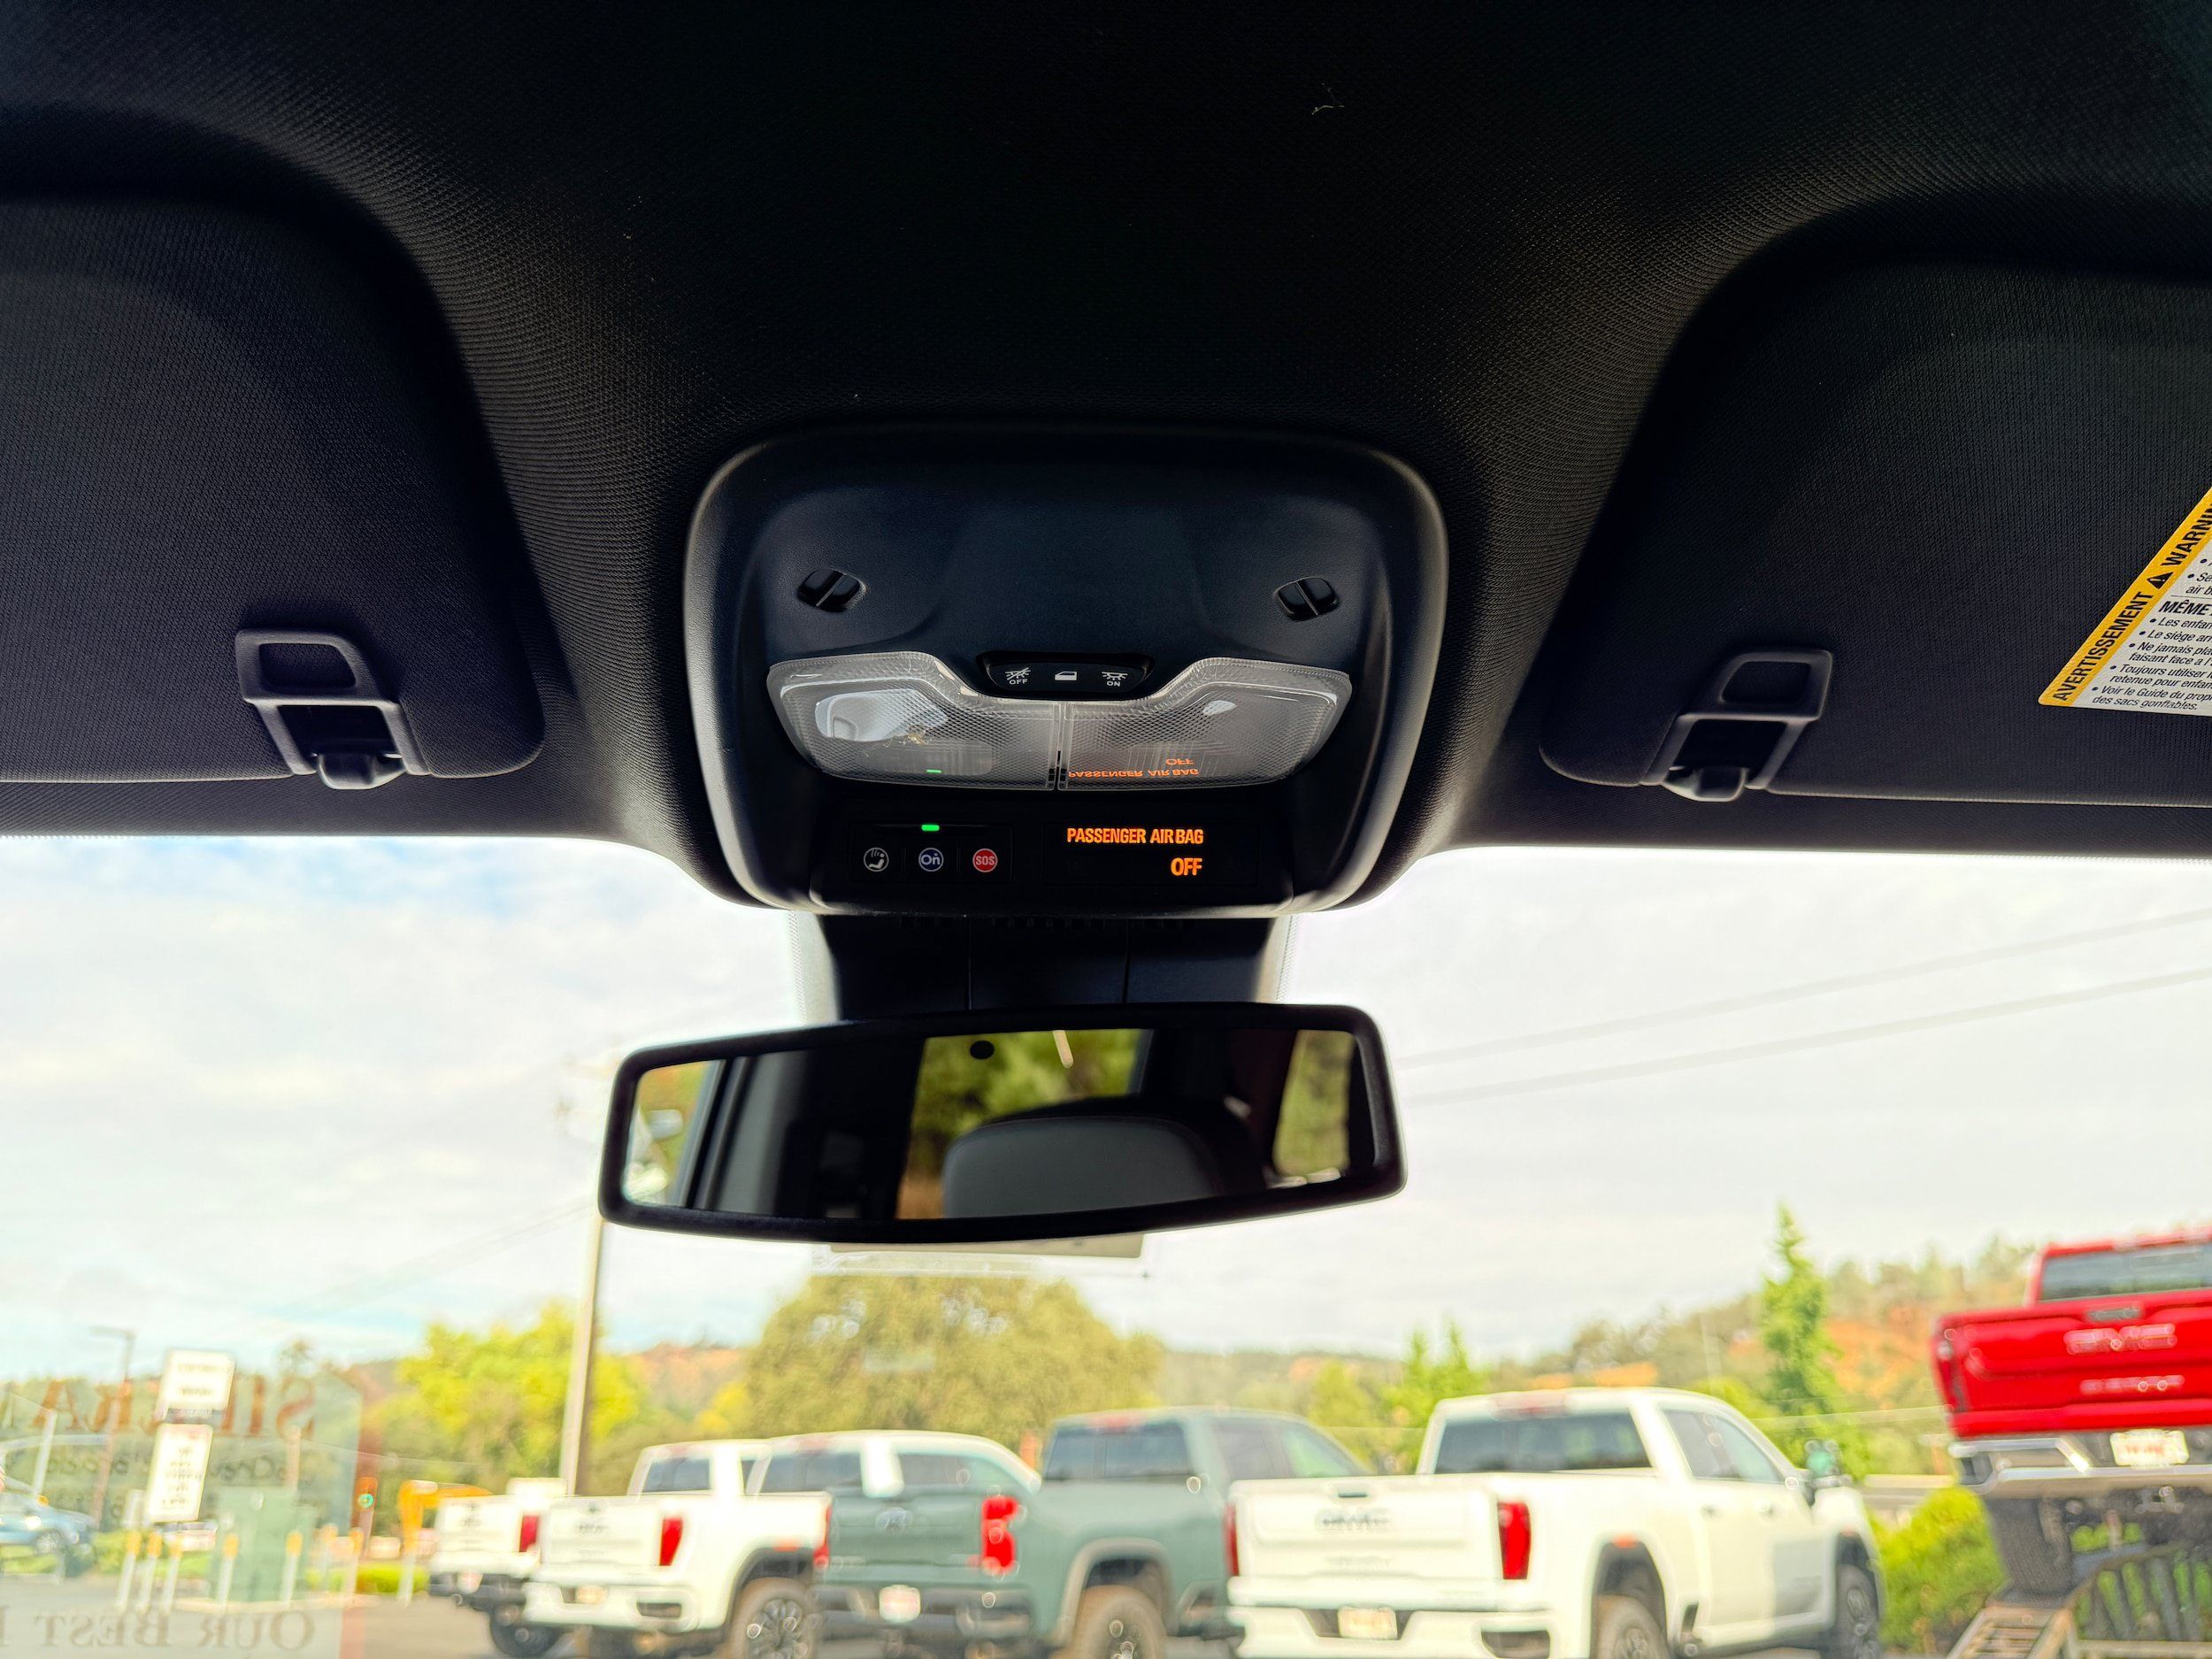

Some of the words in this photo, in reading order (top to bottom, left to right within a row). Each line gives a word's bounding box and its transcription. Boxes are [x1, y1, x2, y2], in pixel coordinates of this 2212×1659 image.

[2196, 572, 2212, 582] Se
[2185, 584, 2205, 594] air
[2158, 599, 2212, 616] MÊME
[2158, 617, 2180, 627] Les
[2147, 629, 2163, 639] Le
[2164, 630, 2196, 642] siège
[2052, 592, 2154, 701] AVERTISSEMENT
[2137, 641, 2154, 651] Ne
[2154, 642, 2193, 654] jamais
[2192, 646, 2212, 656] pla
[2128, 652, 2169, 664] faisant
[2169, 655, 2194, 665] face
[2120, 664, 2167, 676] Toujours
[2168, 668, 2208, 679] utiliser
[2109, 674, 2153, 685] retenue
[2152, 678, 2182, 687] pour
[2181, 680, 2212, 689] enfan
[2101, 685, 2124, 695] Voir
[2124, 687, 2135, 696] le
[2136, 687, 2169, 698] Guide
[2169, 690, 2185, 699] du
[2092, 695, 2113, 704] des
[2113, 697, 2139, 706] sacs
[2140, 699, 2198, 710] gonflables.
[1066, 827, 1147, 844] PASSENGER
[1149, 828, 1174, 844] AIR
[1175, 828, 1204, 845] BAG
[920, 852, 941, 865] On
[975, 856, 995, 865] SOS
[1170, 856, 1203, 877] OFF
